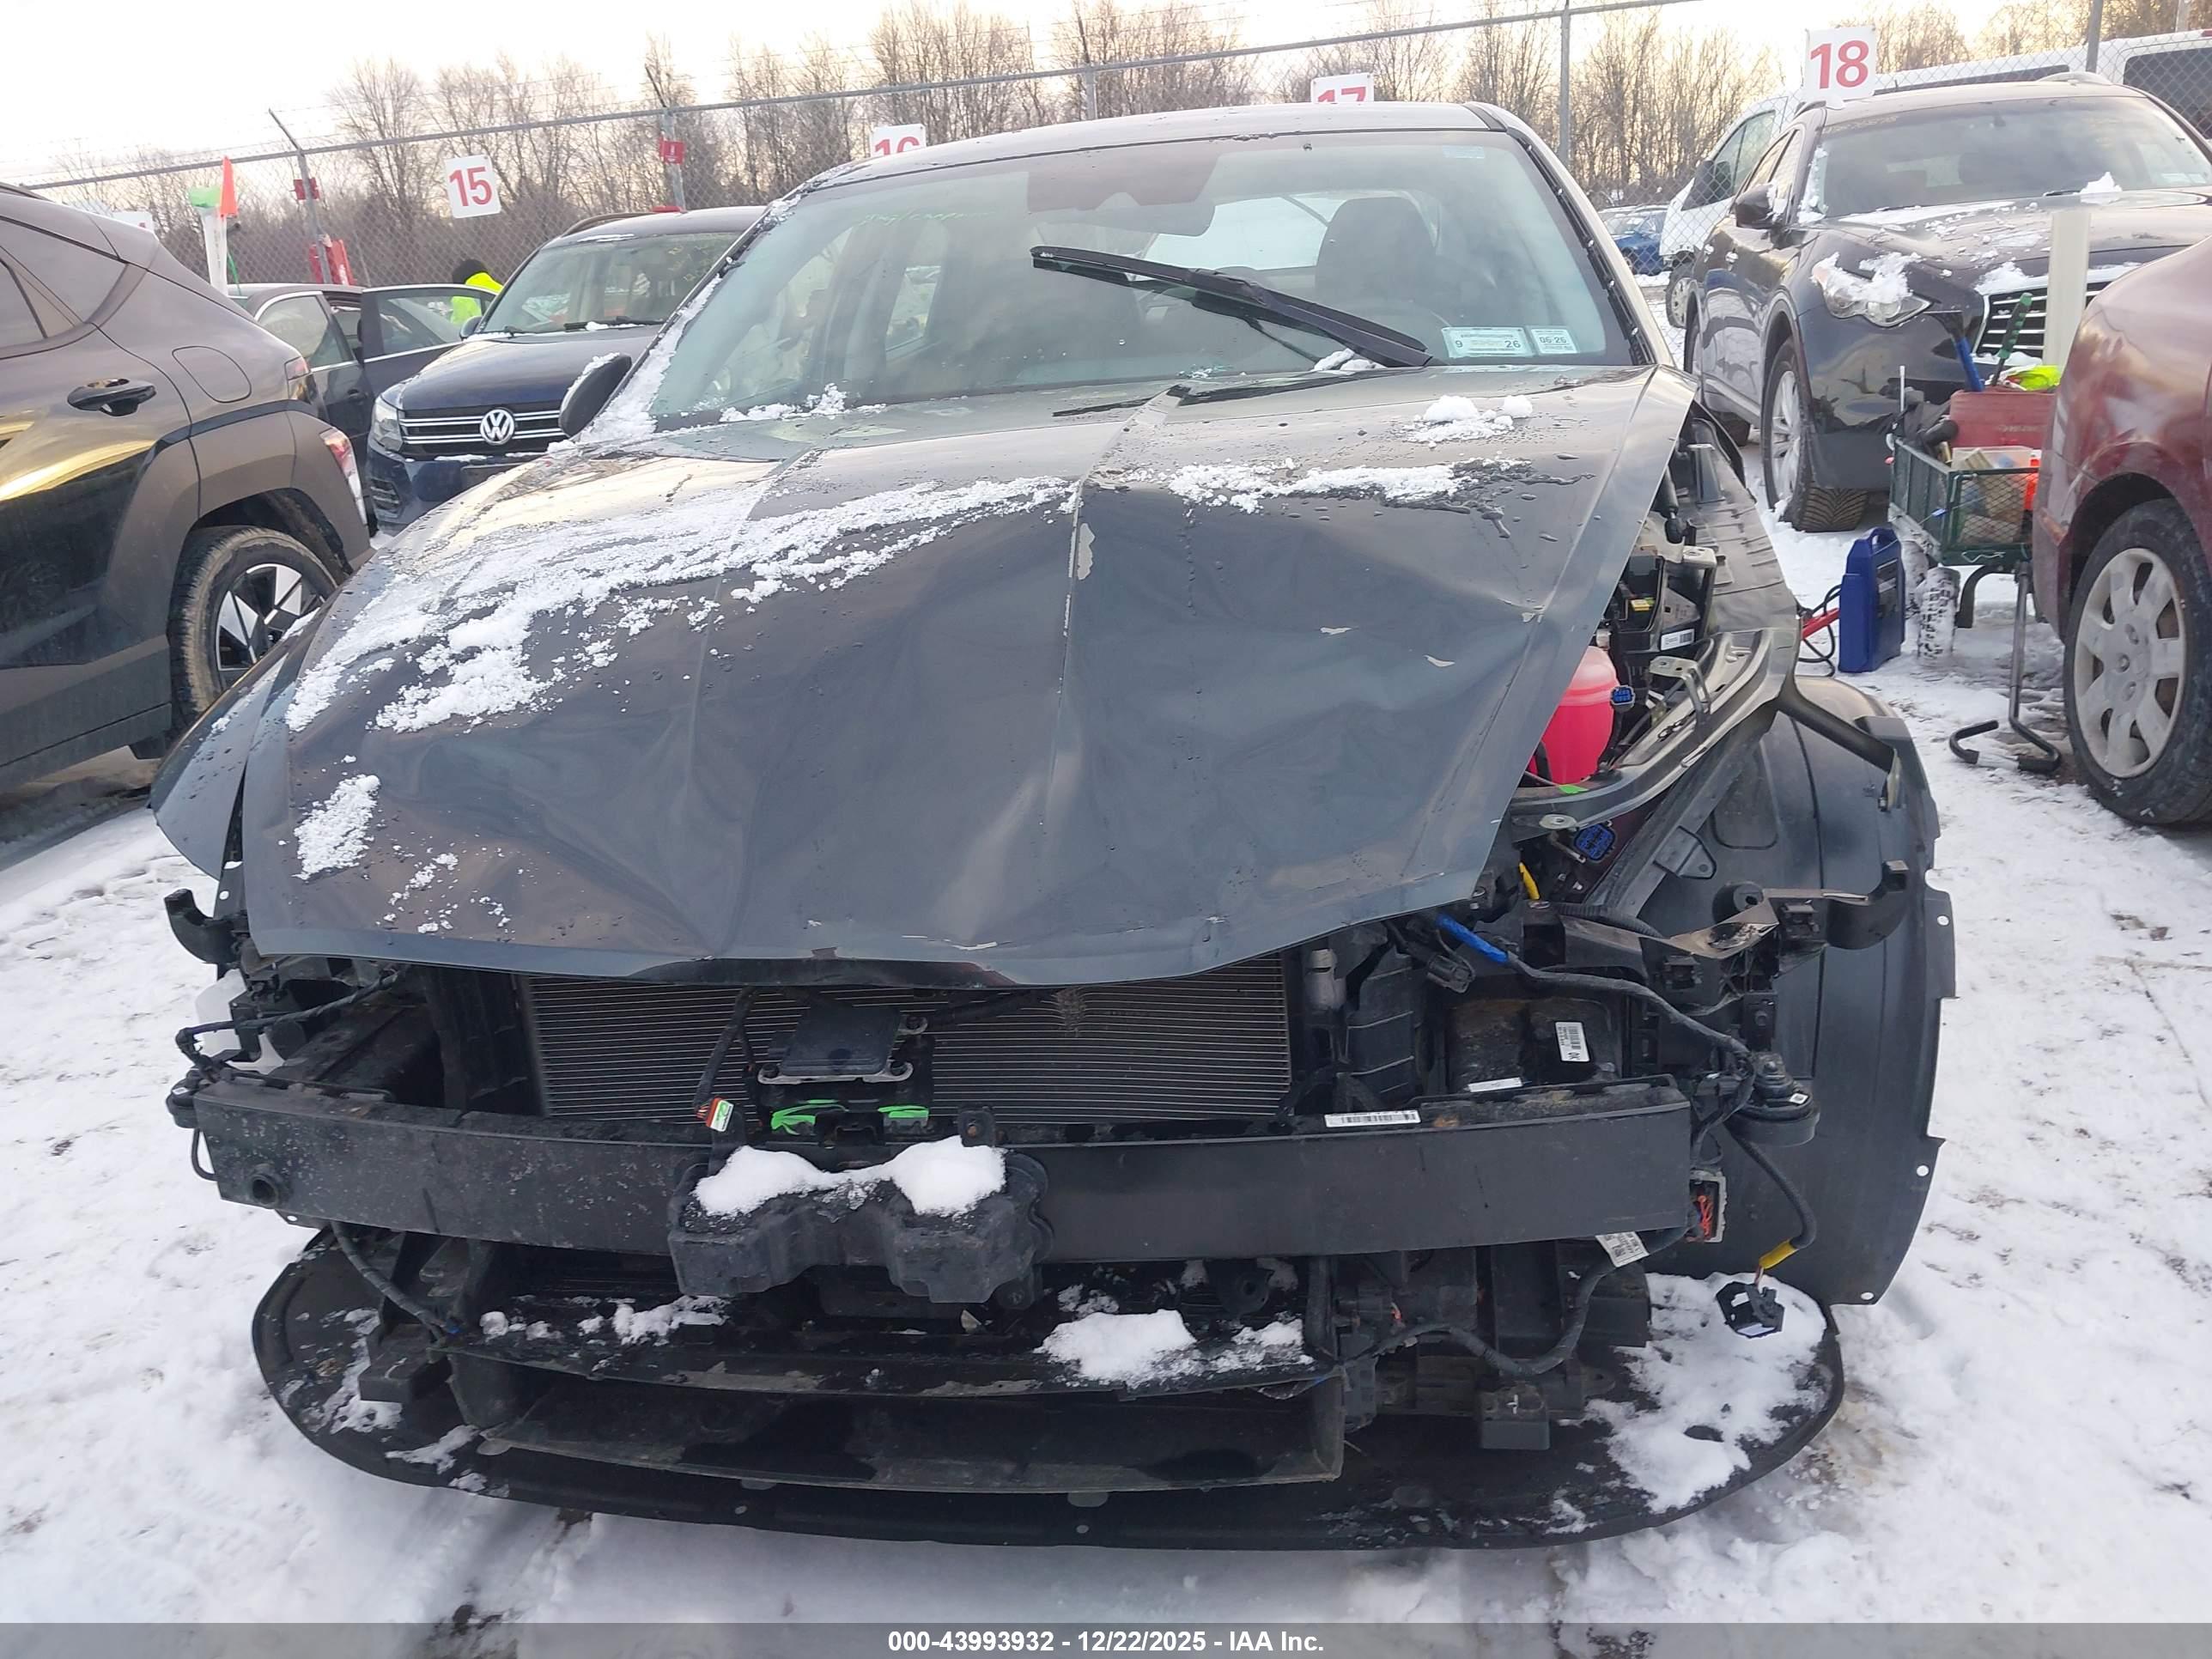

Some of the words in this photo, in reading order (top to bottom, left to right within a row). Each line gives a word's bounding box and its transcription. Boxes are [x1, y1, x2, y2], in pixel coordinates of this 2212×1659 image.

[1809, 40, 1869, 89] 18
[449, 166, 493, 207] 15
[1504, 340, 1522, 349] 26
[482, 410, 513, 443] VW
